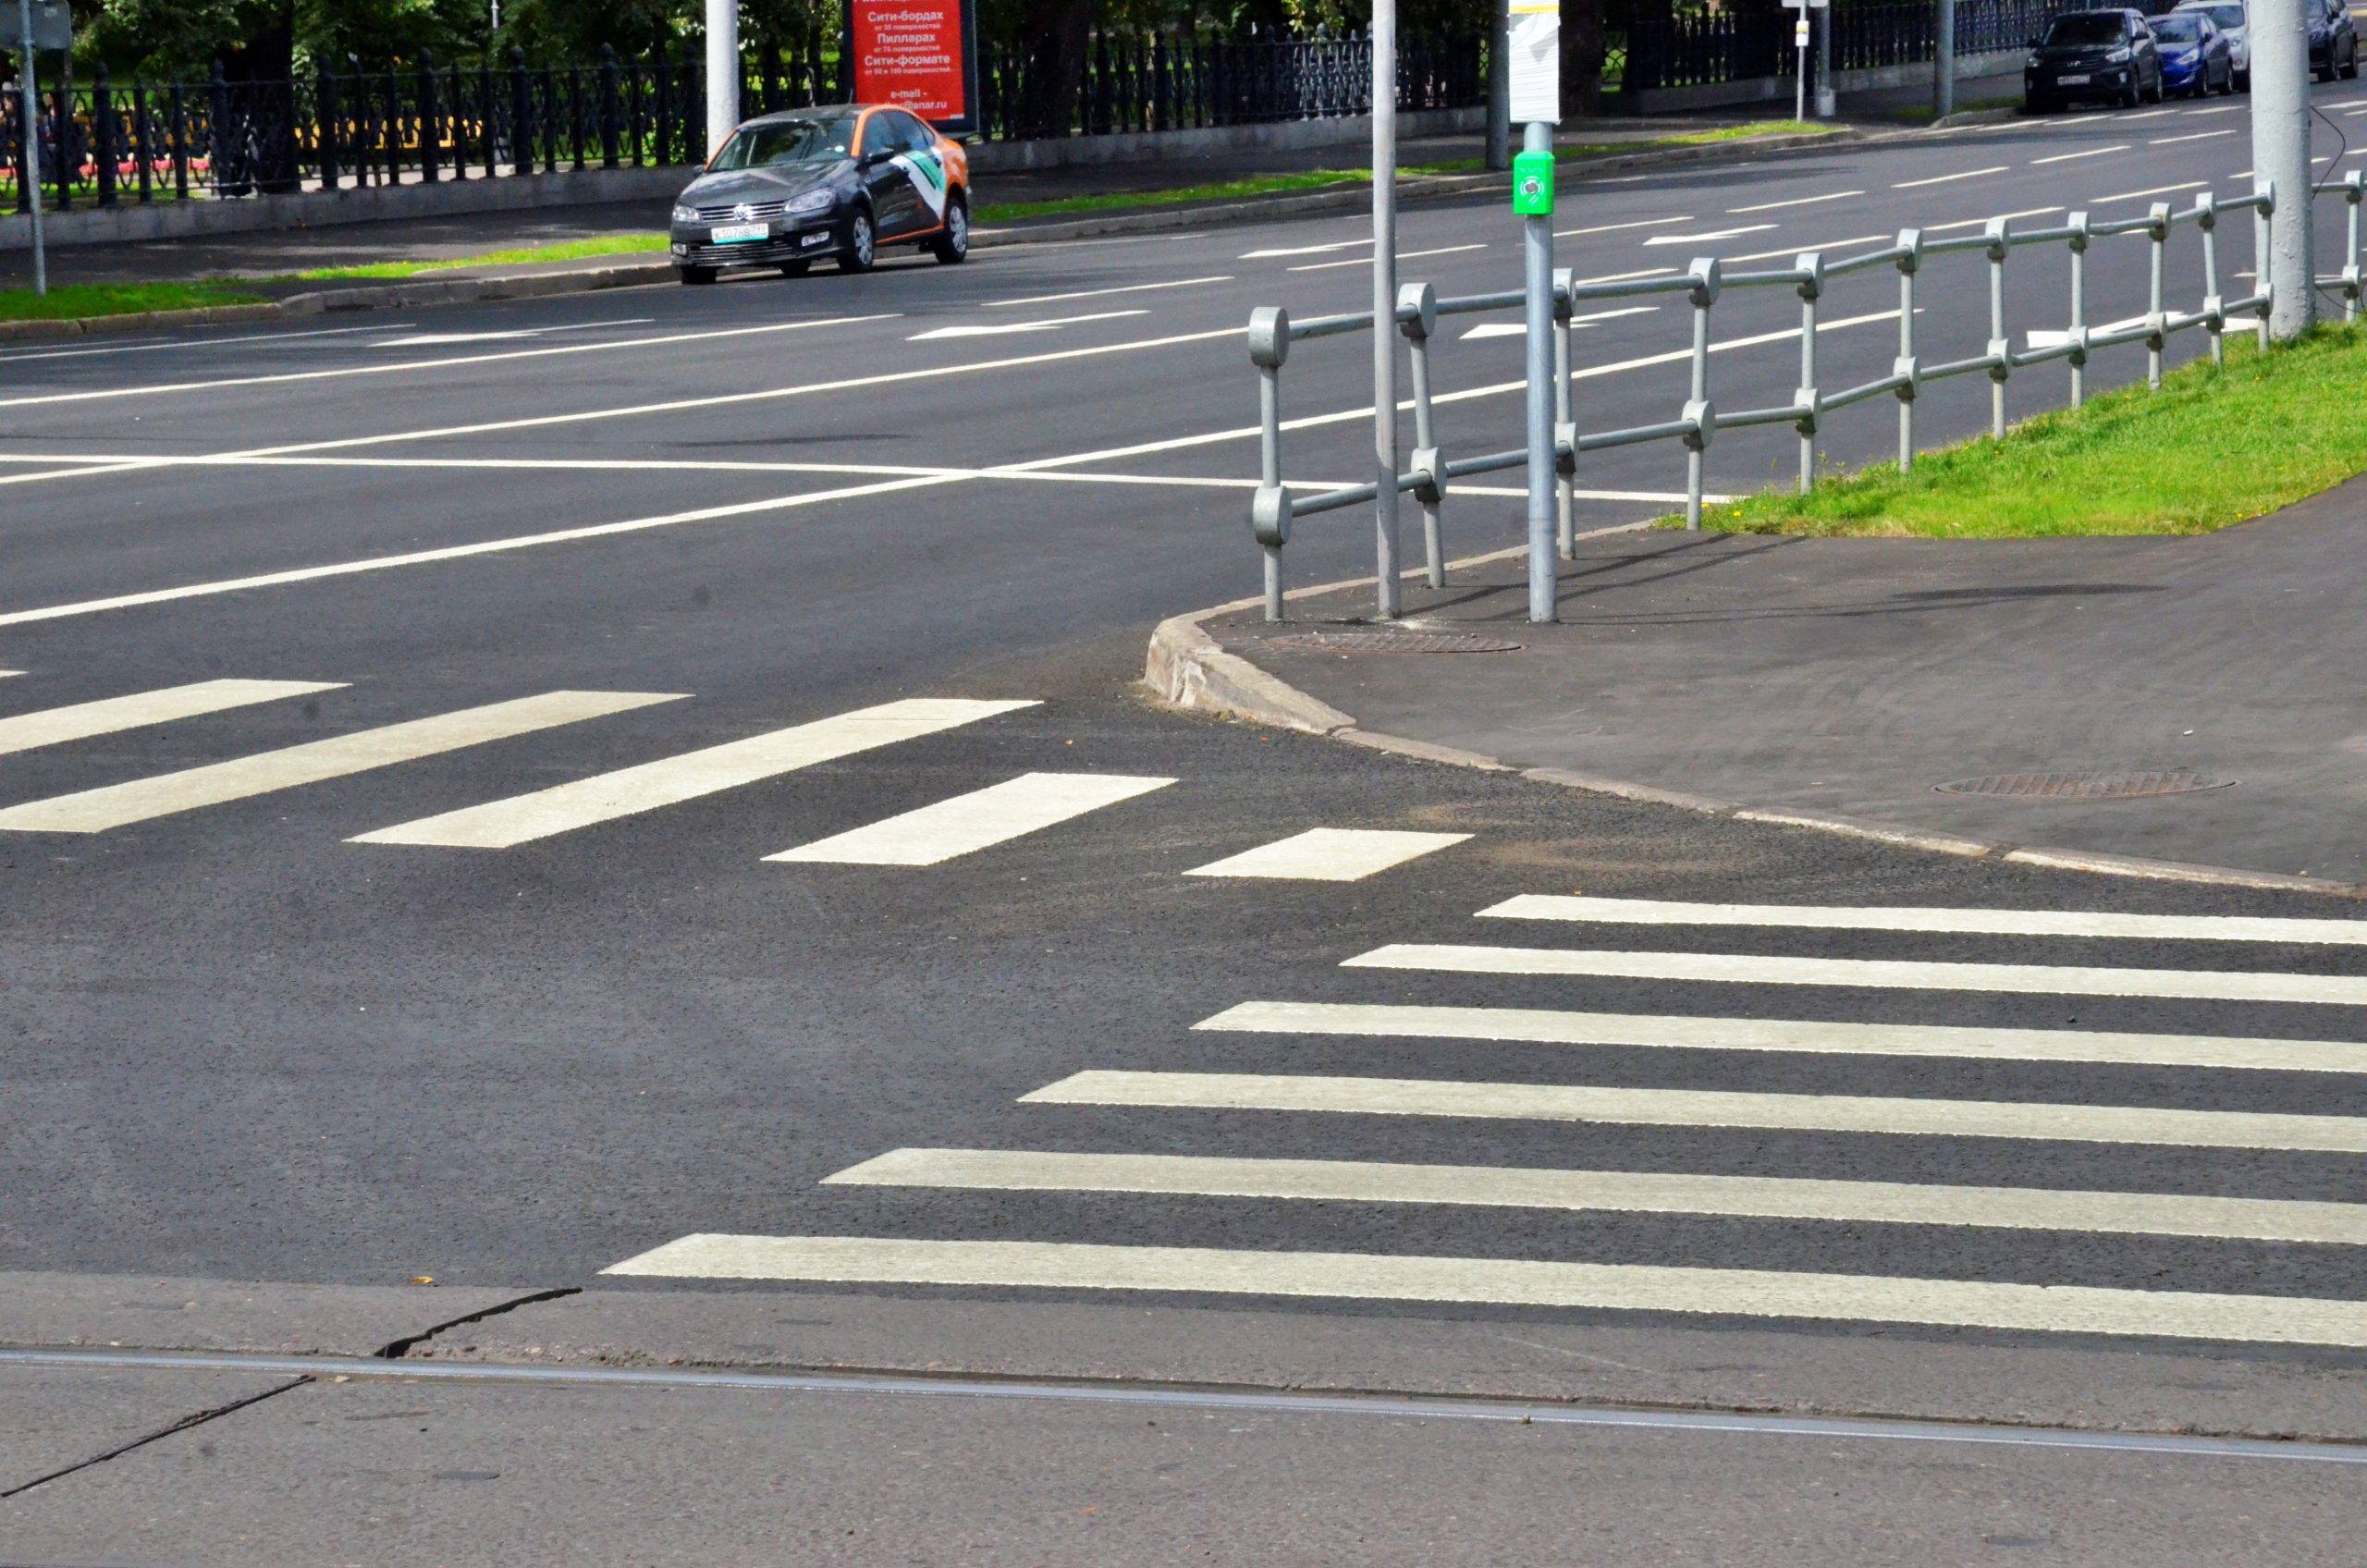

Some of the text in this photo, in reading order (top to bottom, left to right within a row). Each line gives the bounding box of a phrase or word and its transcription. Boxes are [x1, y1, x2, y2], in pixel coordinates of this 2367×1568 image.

[867, 10, 944, 22] Сити-бордах
[877, 32, 936, 44] Пилларах
[865, 54, 950, 67] Сити-формате
[890, 89, 921, 99] e-mail
